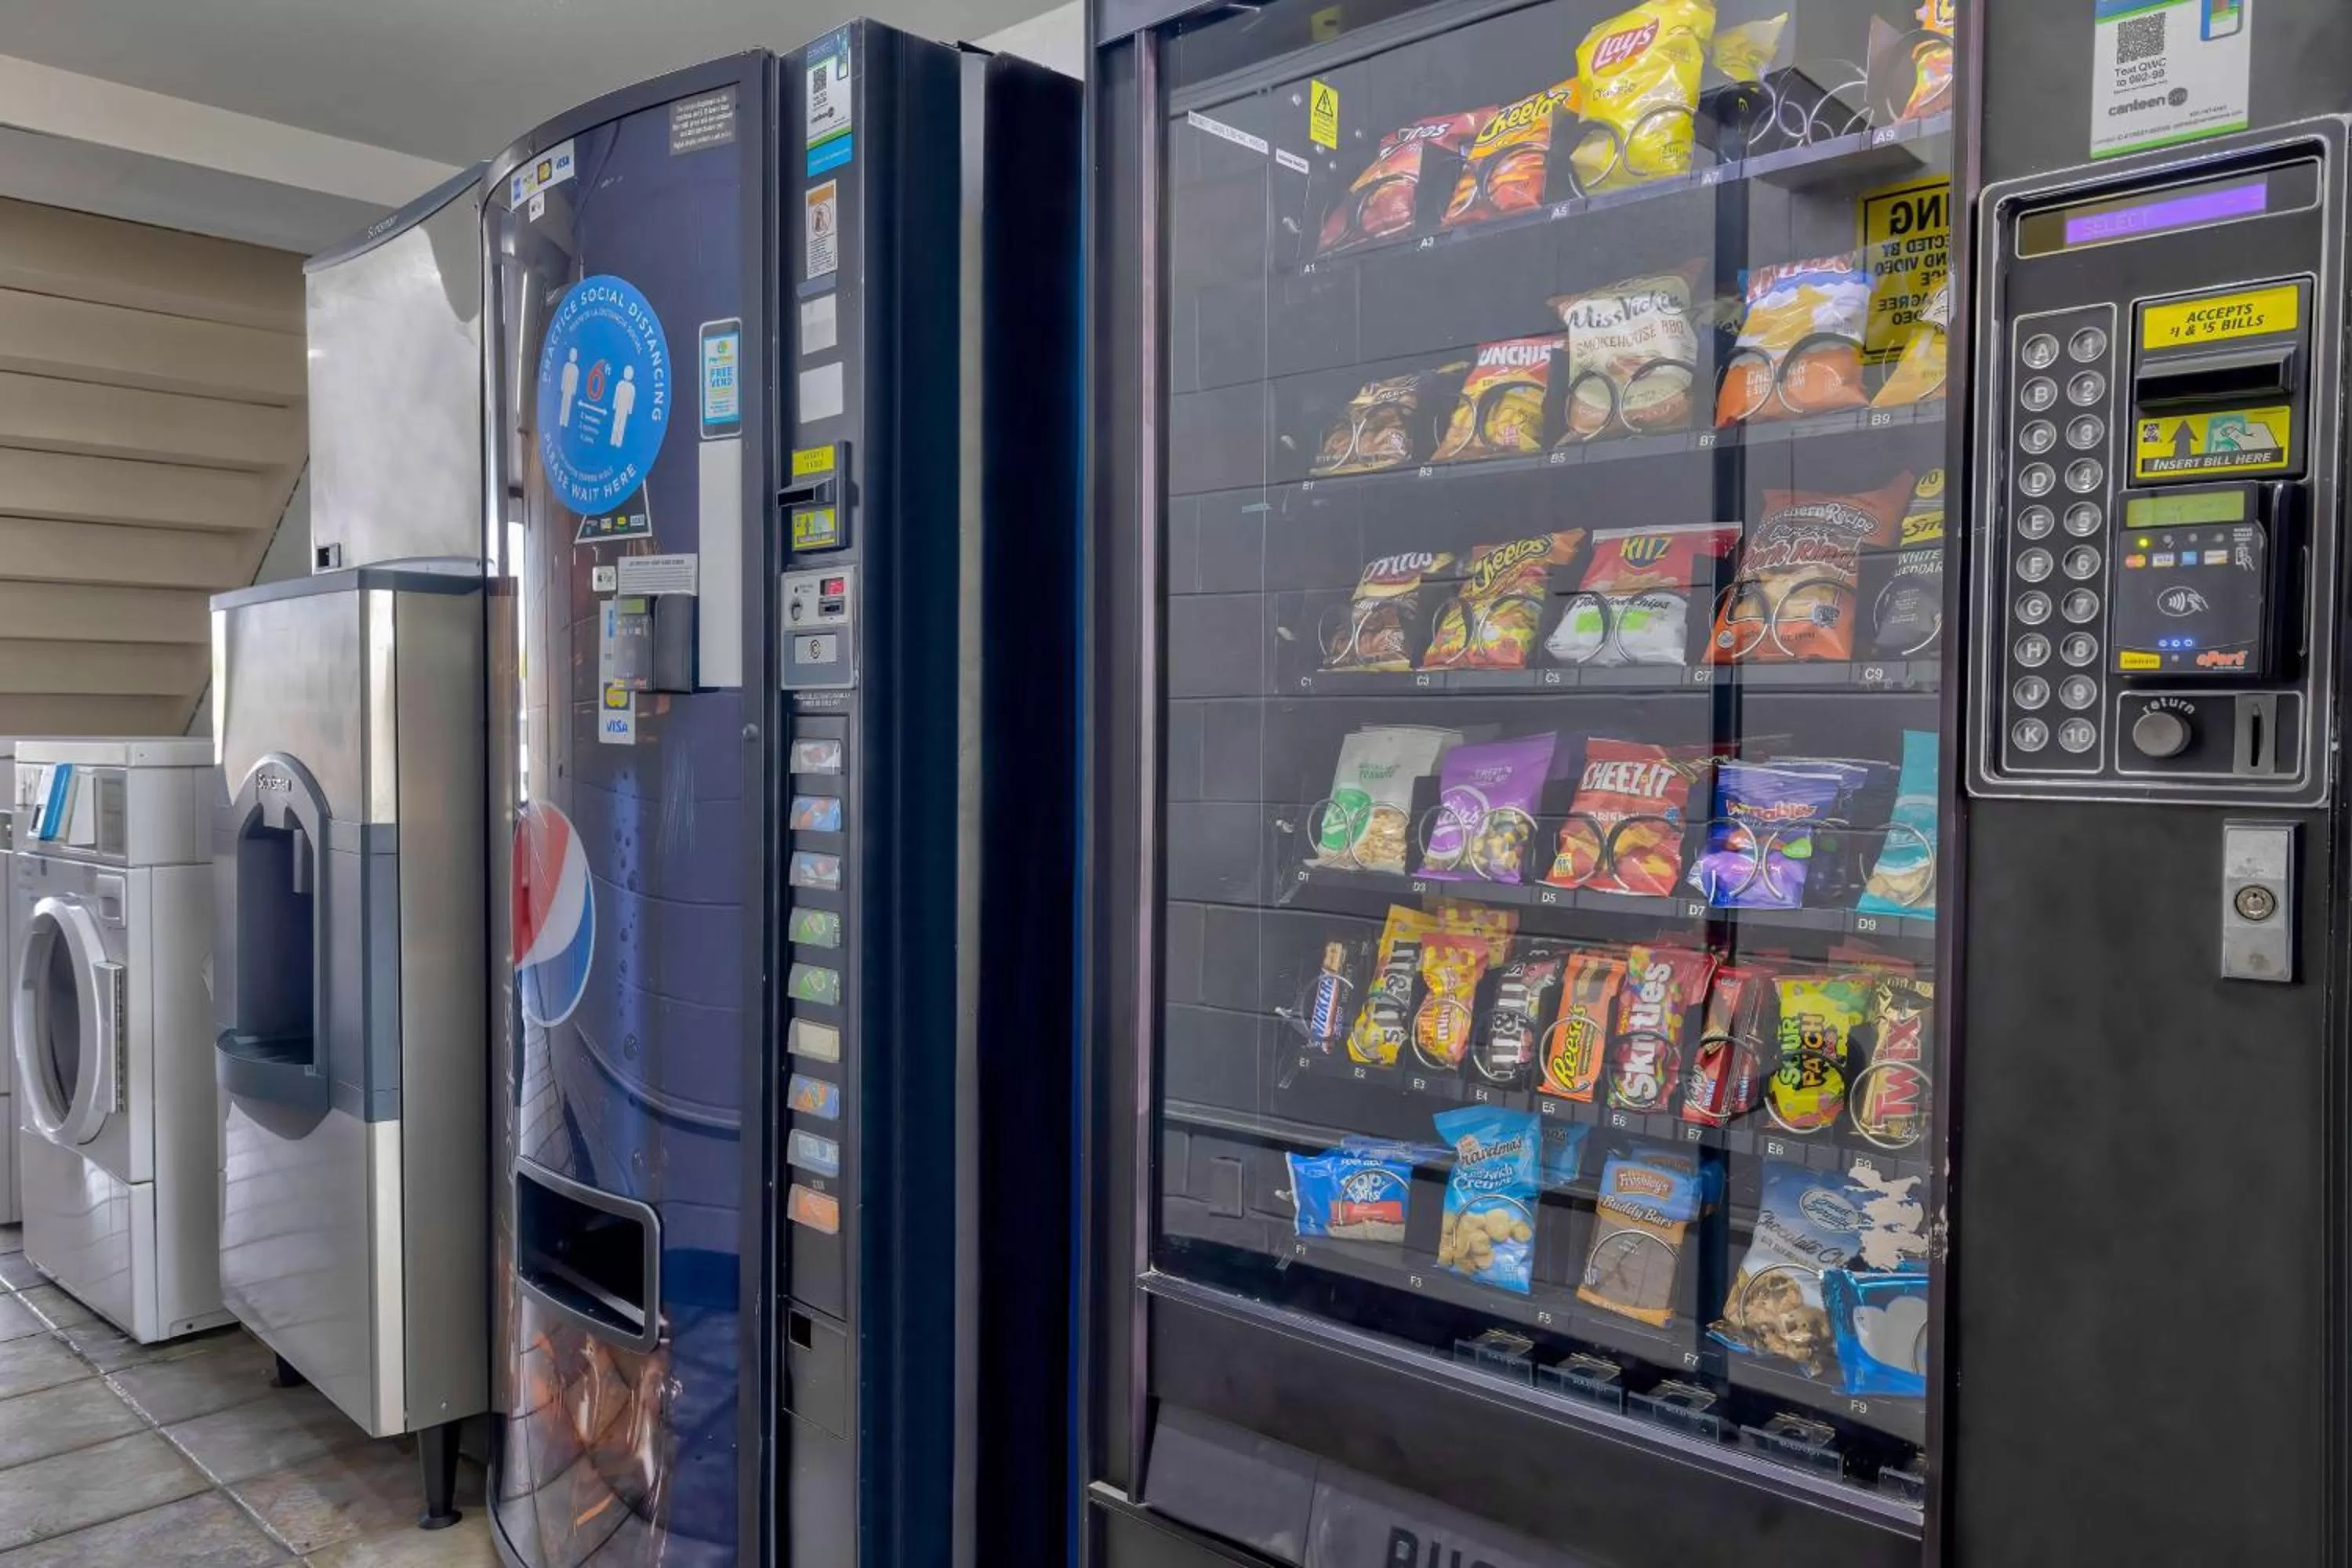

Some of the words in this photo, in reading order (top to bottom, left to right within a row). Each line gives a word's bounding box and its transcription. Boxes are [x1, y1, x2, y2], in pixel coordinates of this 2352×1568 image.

[2114, 65, 2136, 78] Text
[2138, 58, 2168, 71] QWC
[2108, 95, 2166, 117] canteen
[1875, 128, 1895, 143] A9
[1703, 171, 1719, 184] A7
[1551, 205, 1568, 219] A5
[2186, 303, 2254, 323] ACCEPTS
[2221, 314, 2265, 332] BILLS
[581, 287, 624, 307] SOCIAL
[628, 302, 664, 421] DISTANCING
[2034, 343, 2049, 361] A
[2034, 387, 2048, 403] B
[2082, 380, 2094, 397] 2
[1871, 414, 1891, 426] B9
[1700, 435, 1716, 447] B7
[2033, 429, 2048, 446] C
[1551, 452, 1566, 463] B5
[2154, 458, 2201, 470] INSERT
[2204, 455, 2232, 467] BILL
[2235, 452, 2271, 464] HERE
[603, 463, 637, 498] HERE
[2032, 472, 2047, 488] D
[1826, 503, 1875, 532] Recipe
[2031, 514, 2045, 531] E
[2078, 512, 2090, 528] 5
[1898, 550, 1940, 565] WHITE
[2031, 557, 2043, 573] F
[2078, 554, 2089, 572] 6
[2027, 598, 2043, 616] G
[2075, 598, 2088, 615] 7
[2026, 641, 2042, 658] H
[2074, 641, 2086, 658] 8
[1417, 676, 1429, 686] C3
[1545, 673, 1560, 684] C5
[1694, 670, 1713, 681] C7
[1865, 669, 1883, 681] C9
[2026, 684, 2038, 701] J
[2072, 683, 2085, 701] 9
[2141, 696, 2195, 716] return
[606, 719, 628, 733] VISA
[2024, 727, 2038, 743] K
[2067, 727, 2089, 743] 10
[1414, 881, 1425, 892] D3
[1542, 892, 1556, 904] D5
[1689, 905, 1706, 916] D7
[1858, 918, 1876, 931] D9
[1552, 1004, 1588, 1090] Reese's
[1355, 1068, 1367, 1079] E2
[1873, 1016, 1922, 1128] TWIX
[1414, 1078, 1425, 1090] E3
[1476, 1090, 1488, 1102] E4
[1542, 1102, 1555, 1114] E5
[1612, 1114, 1626, 1126] E6
[1689, 1129, 1703, 1141] E7
[1768, 1142, 1784, 1155] E8
[1601, 1195, 1644, 1221] Buddy
[1644, 1208, 1674, 1229] Bars
[1411, 1276, 1421, 1287] F3
[1538, 1311, 1552, 1324] F5
[1684, 1352, 1699, 1366] F7
[1850, 1400, 1866, 1414] F9
